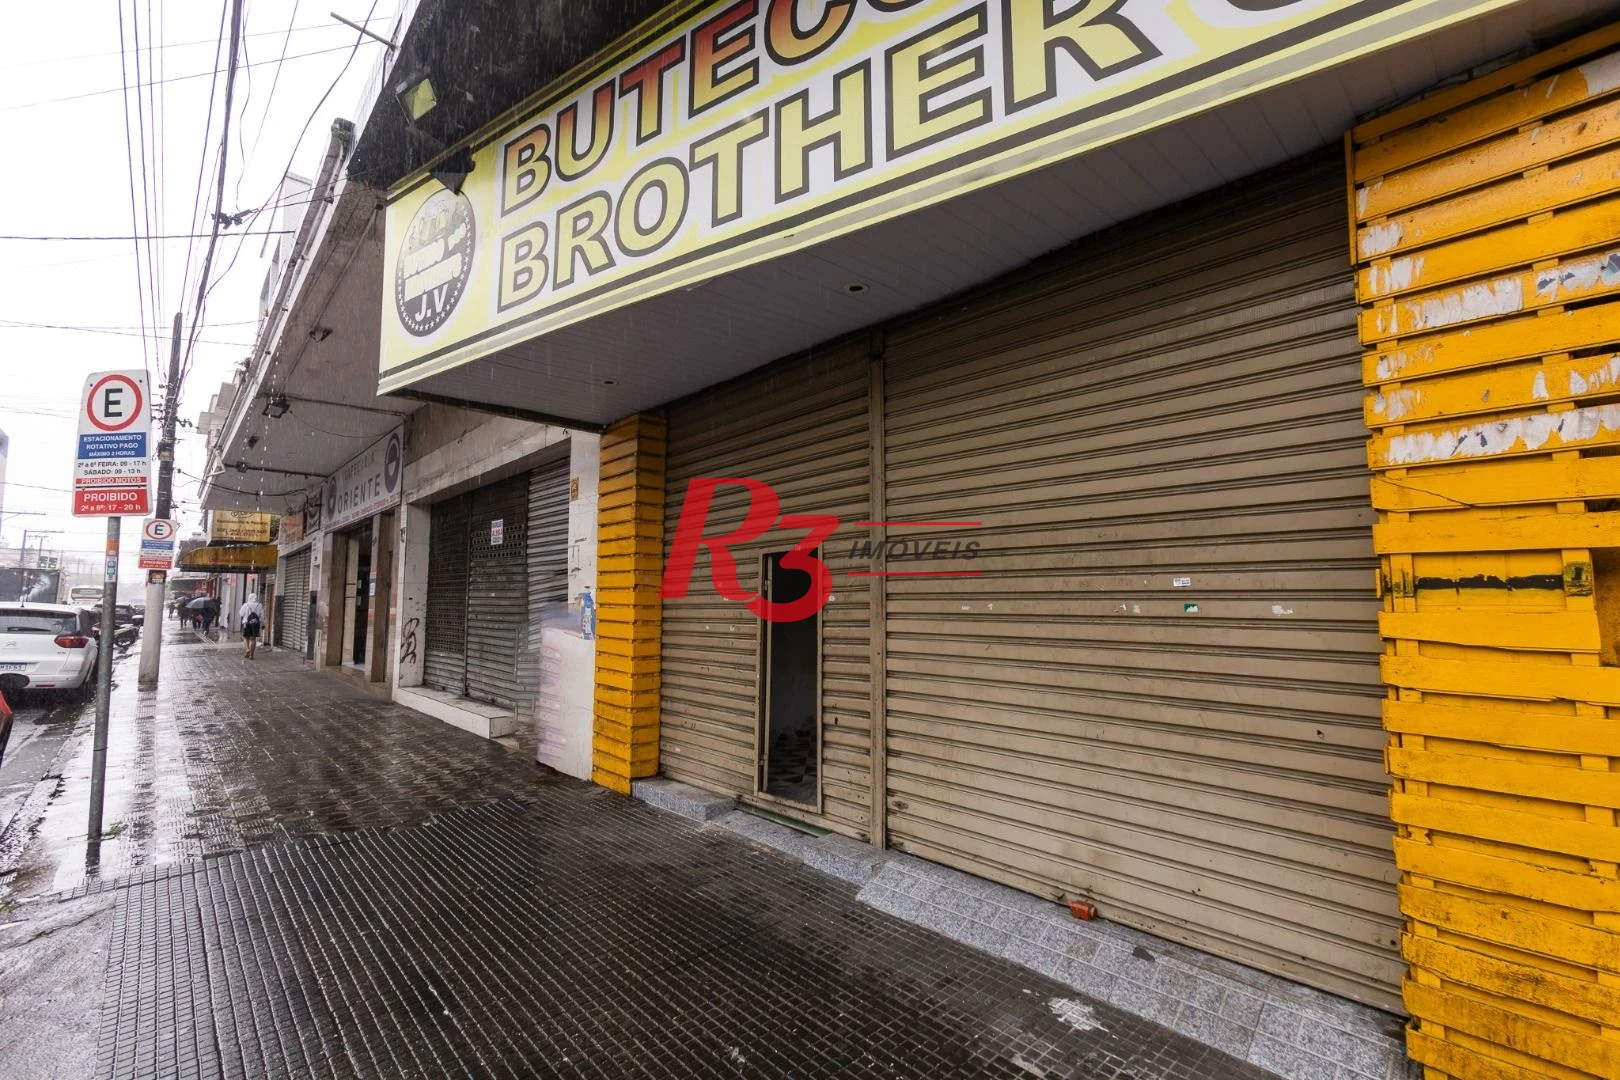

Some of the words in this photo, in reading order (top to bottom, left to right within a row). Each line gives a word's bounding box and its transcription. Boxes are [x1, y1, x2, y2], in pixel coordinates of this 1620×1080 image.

[501, 0, 928, 217] BUTEC
[497, 0, 1300, 314] BROTHER
[415, 284, 448, 321] J.V
[104, 388, 123, 418] E
[84, 492, 138, 502] PROIBIDO
[338, 473, 380, 514] ORIENTE
[155, 524, 164, 535] E
